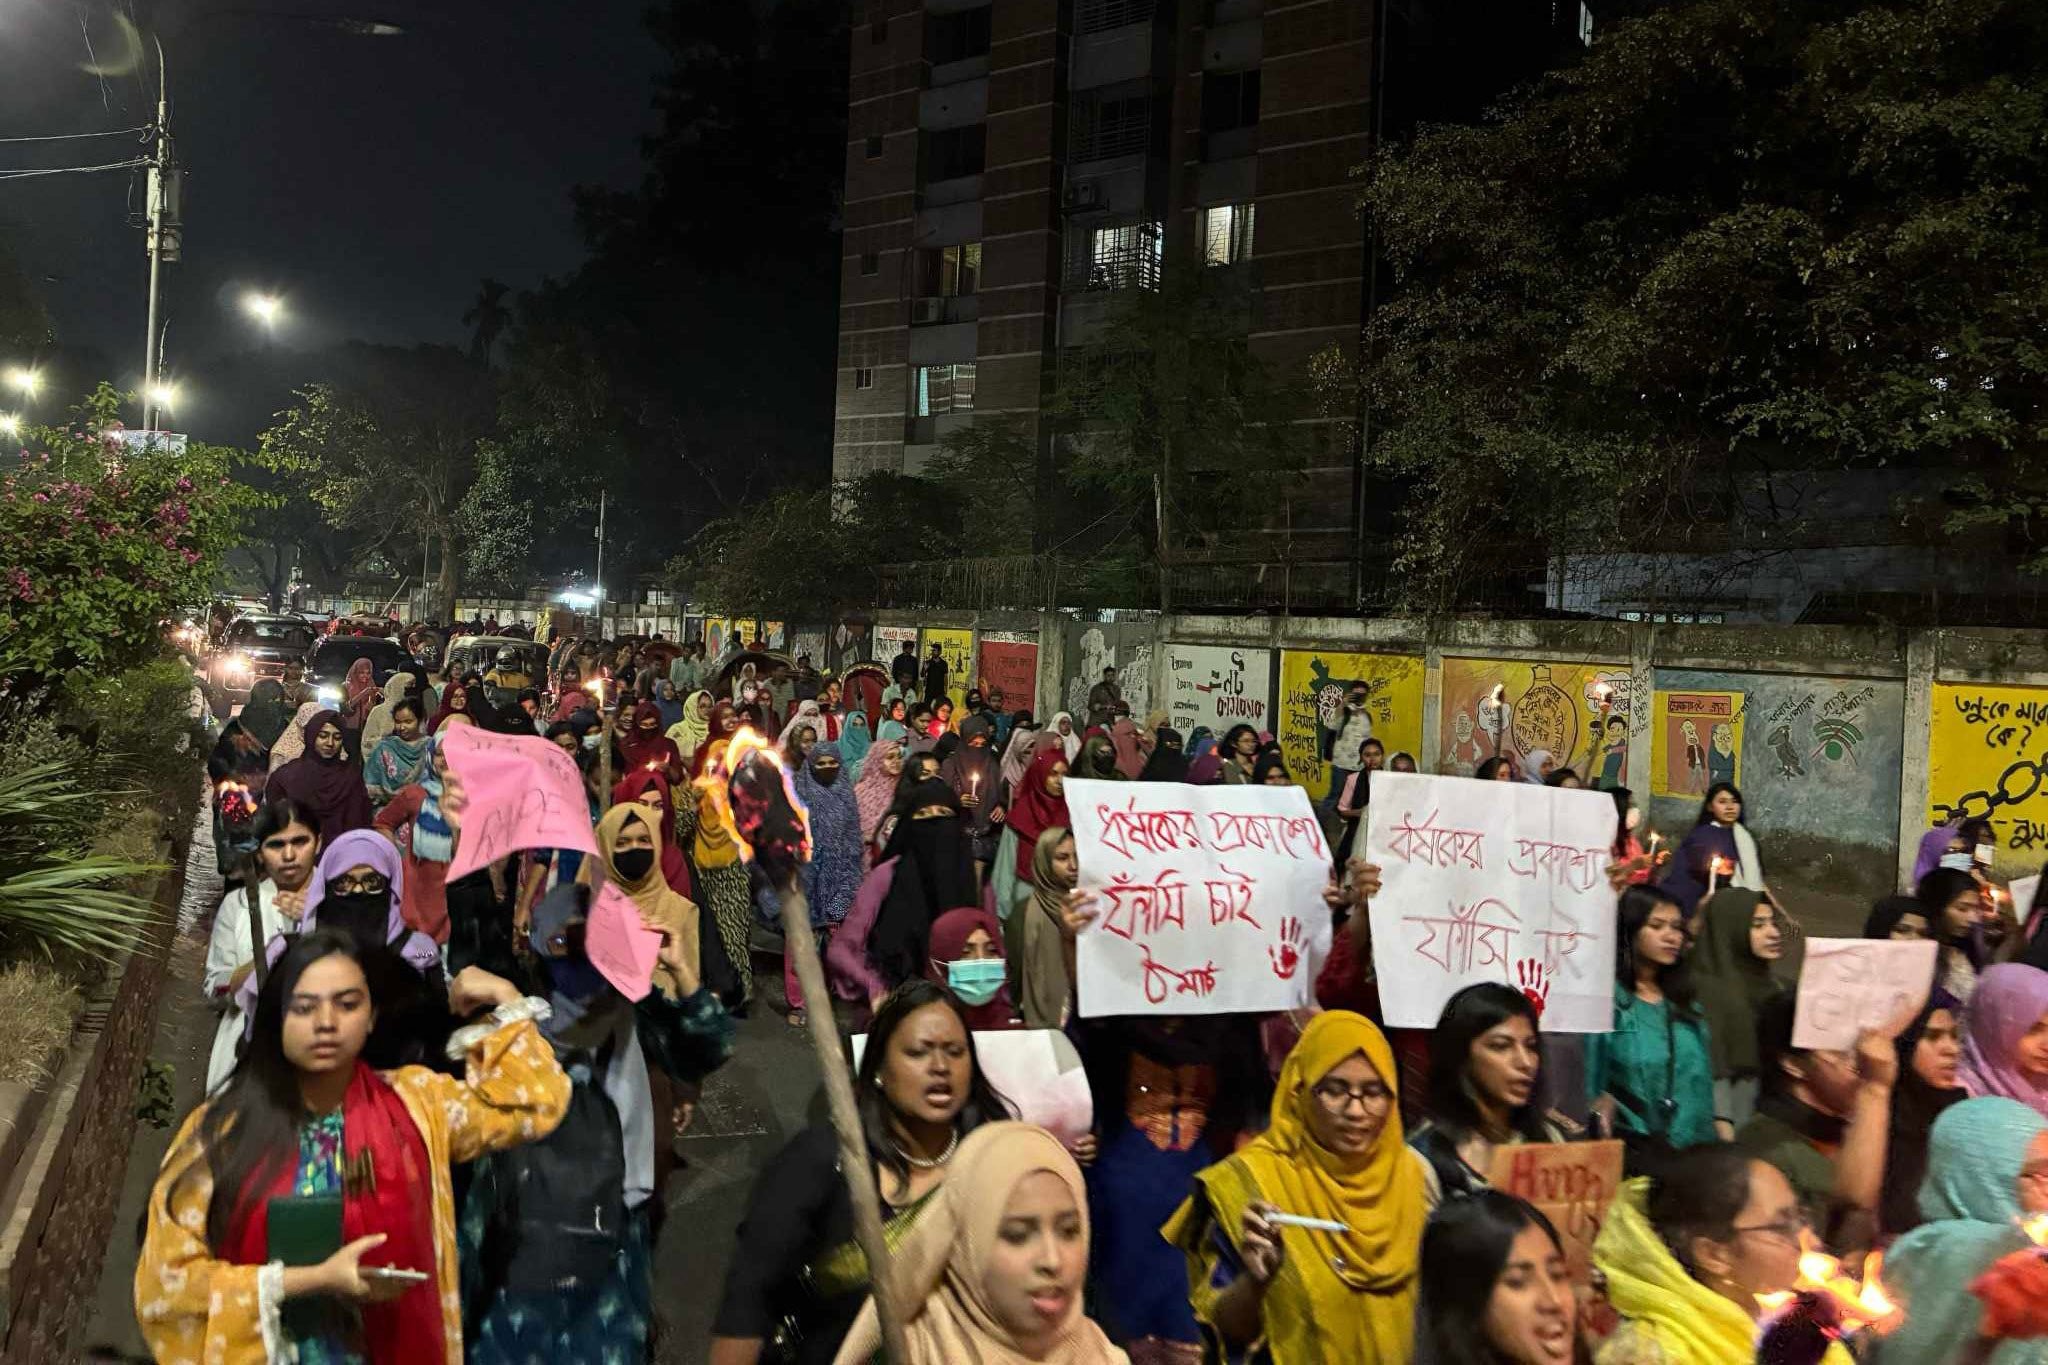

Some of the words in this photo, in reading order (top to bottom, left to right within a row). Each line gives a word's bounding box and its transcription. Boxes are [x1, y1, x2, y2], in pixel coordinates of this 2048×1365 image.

[1093, 796, 1206, 861] ধর্ষকের
[1202, 864, 1265, 931] চাই
[1400, 898, 1520, 985] ফাঁসি
